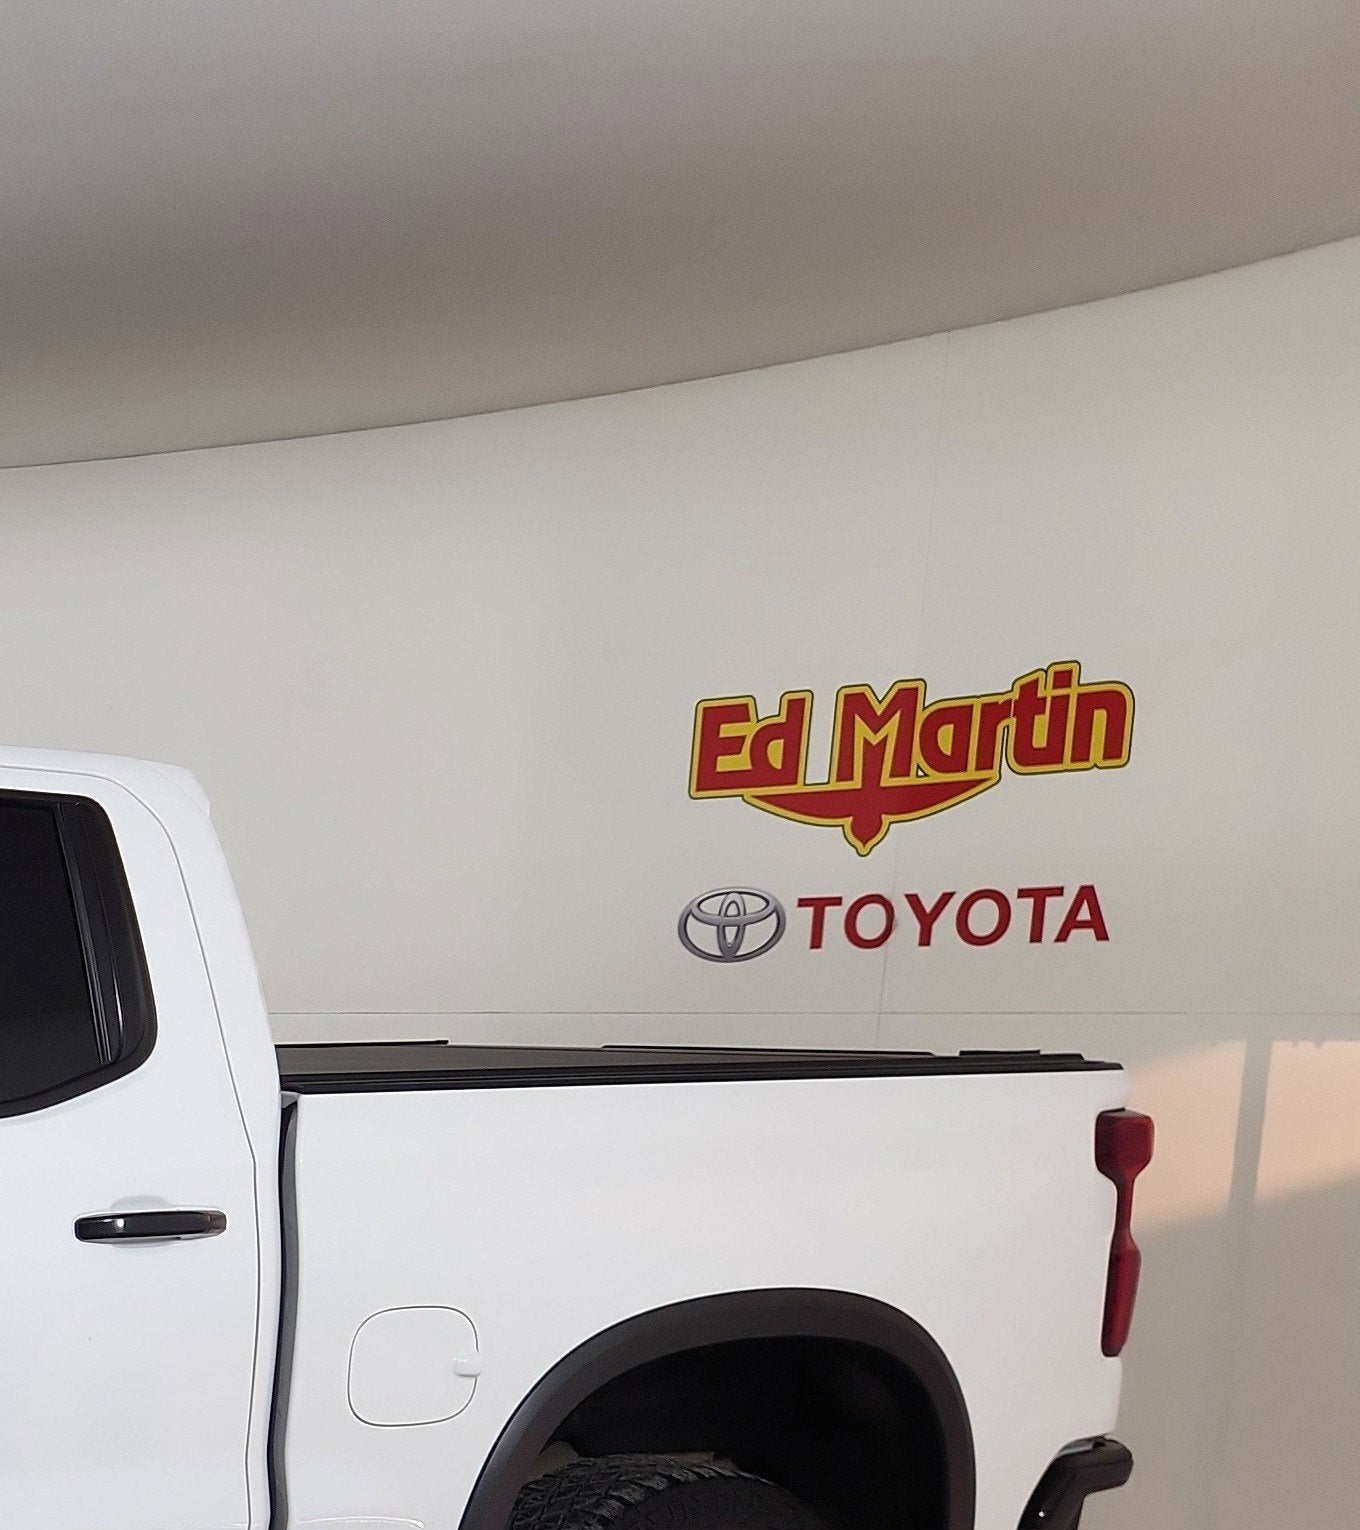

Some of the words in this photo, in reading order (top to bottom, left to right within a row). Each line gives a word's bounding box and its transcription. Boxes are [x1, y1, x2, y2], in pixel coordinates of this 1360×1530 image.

[692, 695, 810, 794] Ed
[831, 664, 1132, 786] Martin
[797, 884, 1110, 950] TOYOTA
